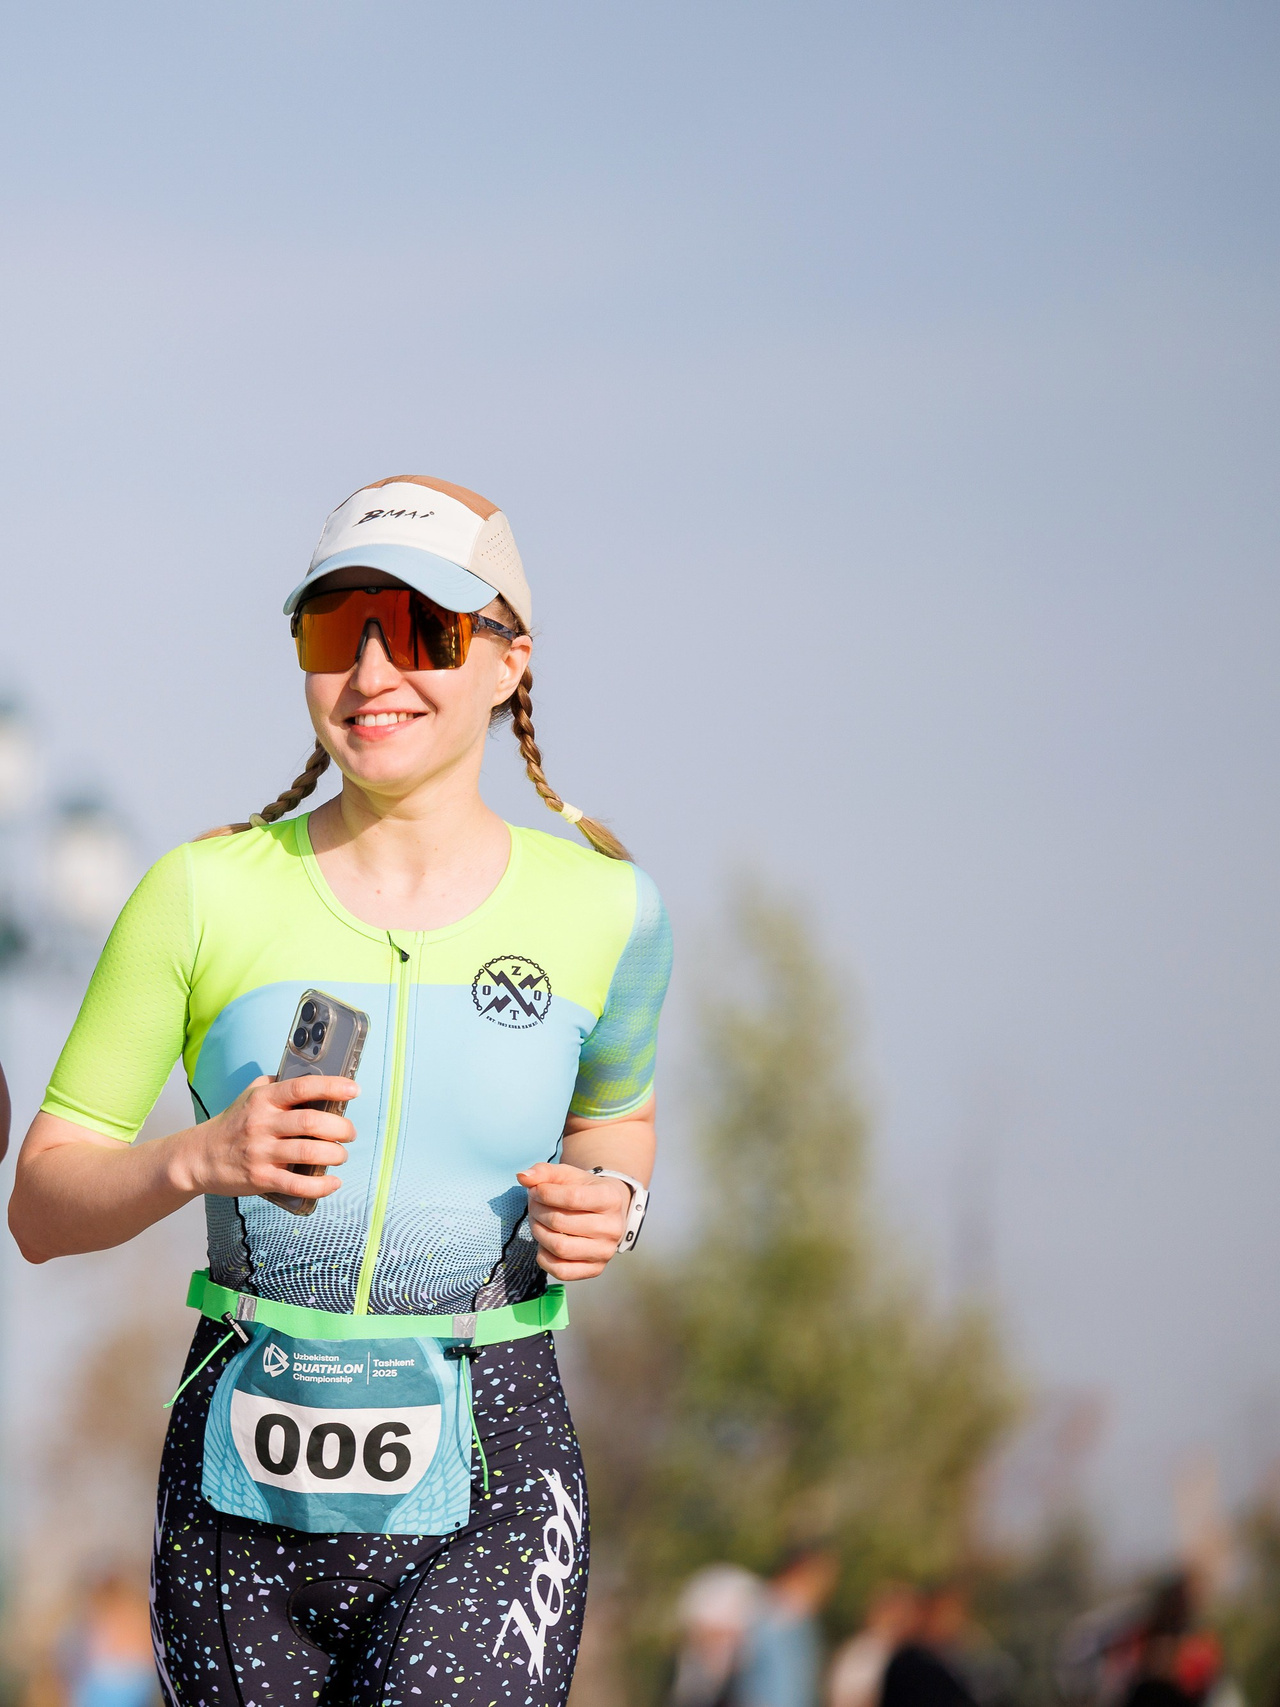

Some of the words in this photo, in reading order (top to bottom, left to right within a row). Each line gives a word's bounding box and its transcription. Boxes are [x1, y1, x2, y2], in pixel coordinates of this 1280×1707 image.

[293, 1352, 340, 1362] Uzbekistan
[292, 1362, 364, 1374] DUATHLON
[372, 1358, 415, 1368] Tashkent
[292, 1373, 353, 1384] Championship
[371, 1369, 398, 1378] 2025
[254, 1413, 412, 1482] 006
